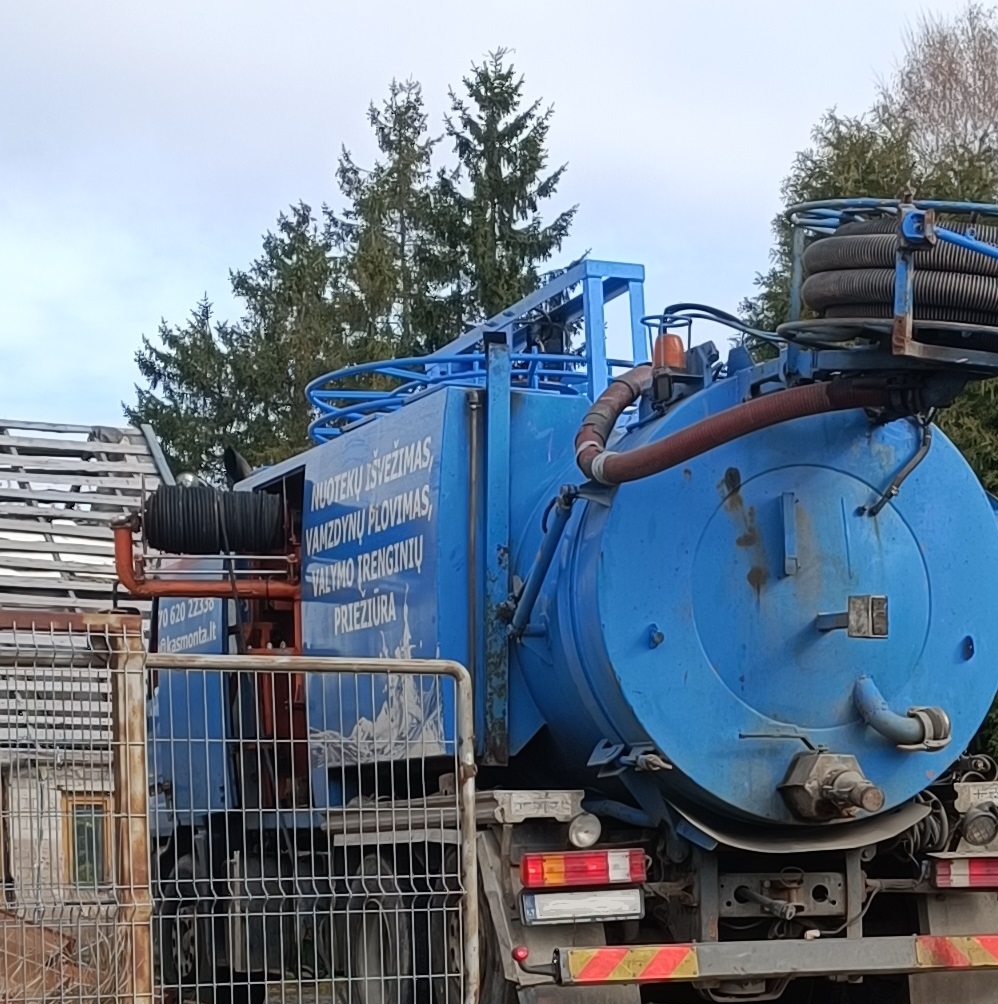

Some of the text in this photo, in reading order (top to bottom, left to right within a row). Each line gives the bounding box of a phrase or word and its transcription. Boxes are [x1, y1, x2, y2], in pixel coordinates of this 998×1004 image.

[311, 436, 434, 512] NUOTEKŲ IŠVEŽIMAS,
[305, 485, 433, 556] VAMZDYNŲ PLOVIMAS,
[311, 535, 424, 597] VALYMO ĮRENGINIŲ
[170, 602, 185, 625] 620
[334, 588, 397, 636] PRIEŽIŪRA
